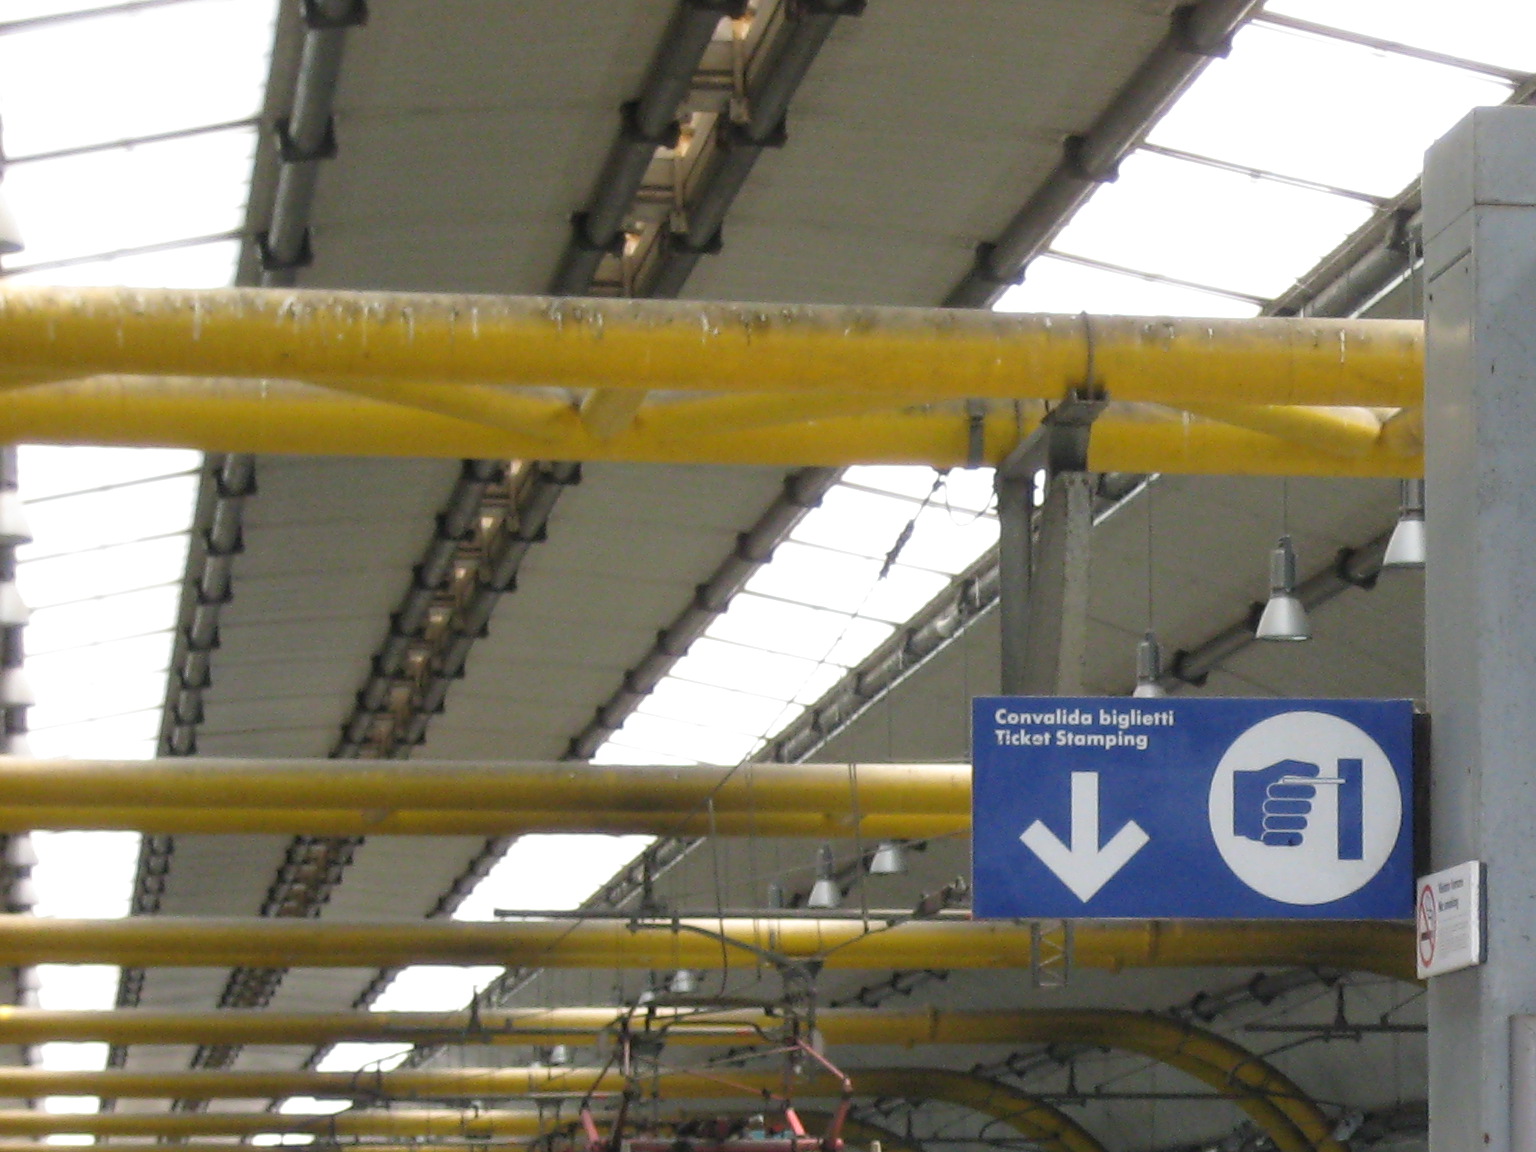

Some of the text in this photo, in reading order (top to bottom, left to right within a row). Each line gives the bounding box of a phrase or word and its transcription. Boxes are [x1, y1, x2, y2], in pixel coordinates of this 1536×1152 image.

[995, 708, 1174, 729] Convalida biglietti
[995, 729, 1148, 750] Ticket Stamping
